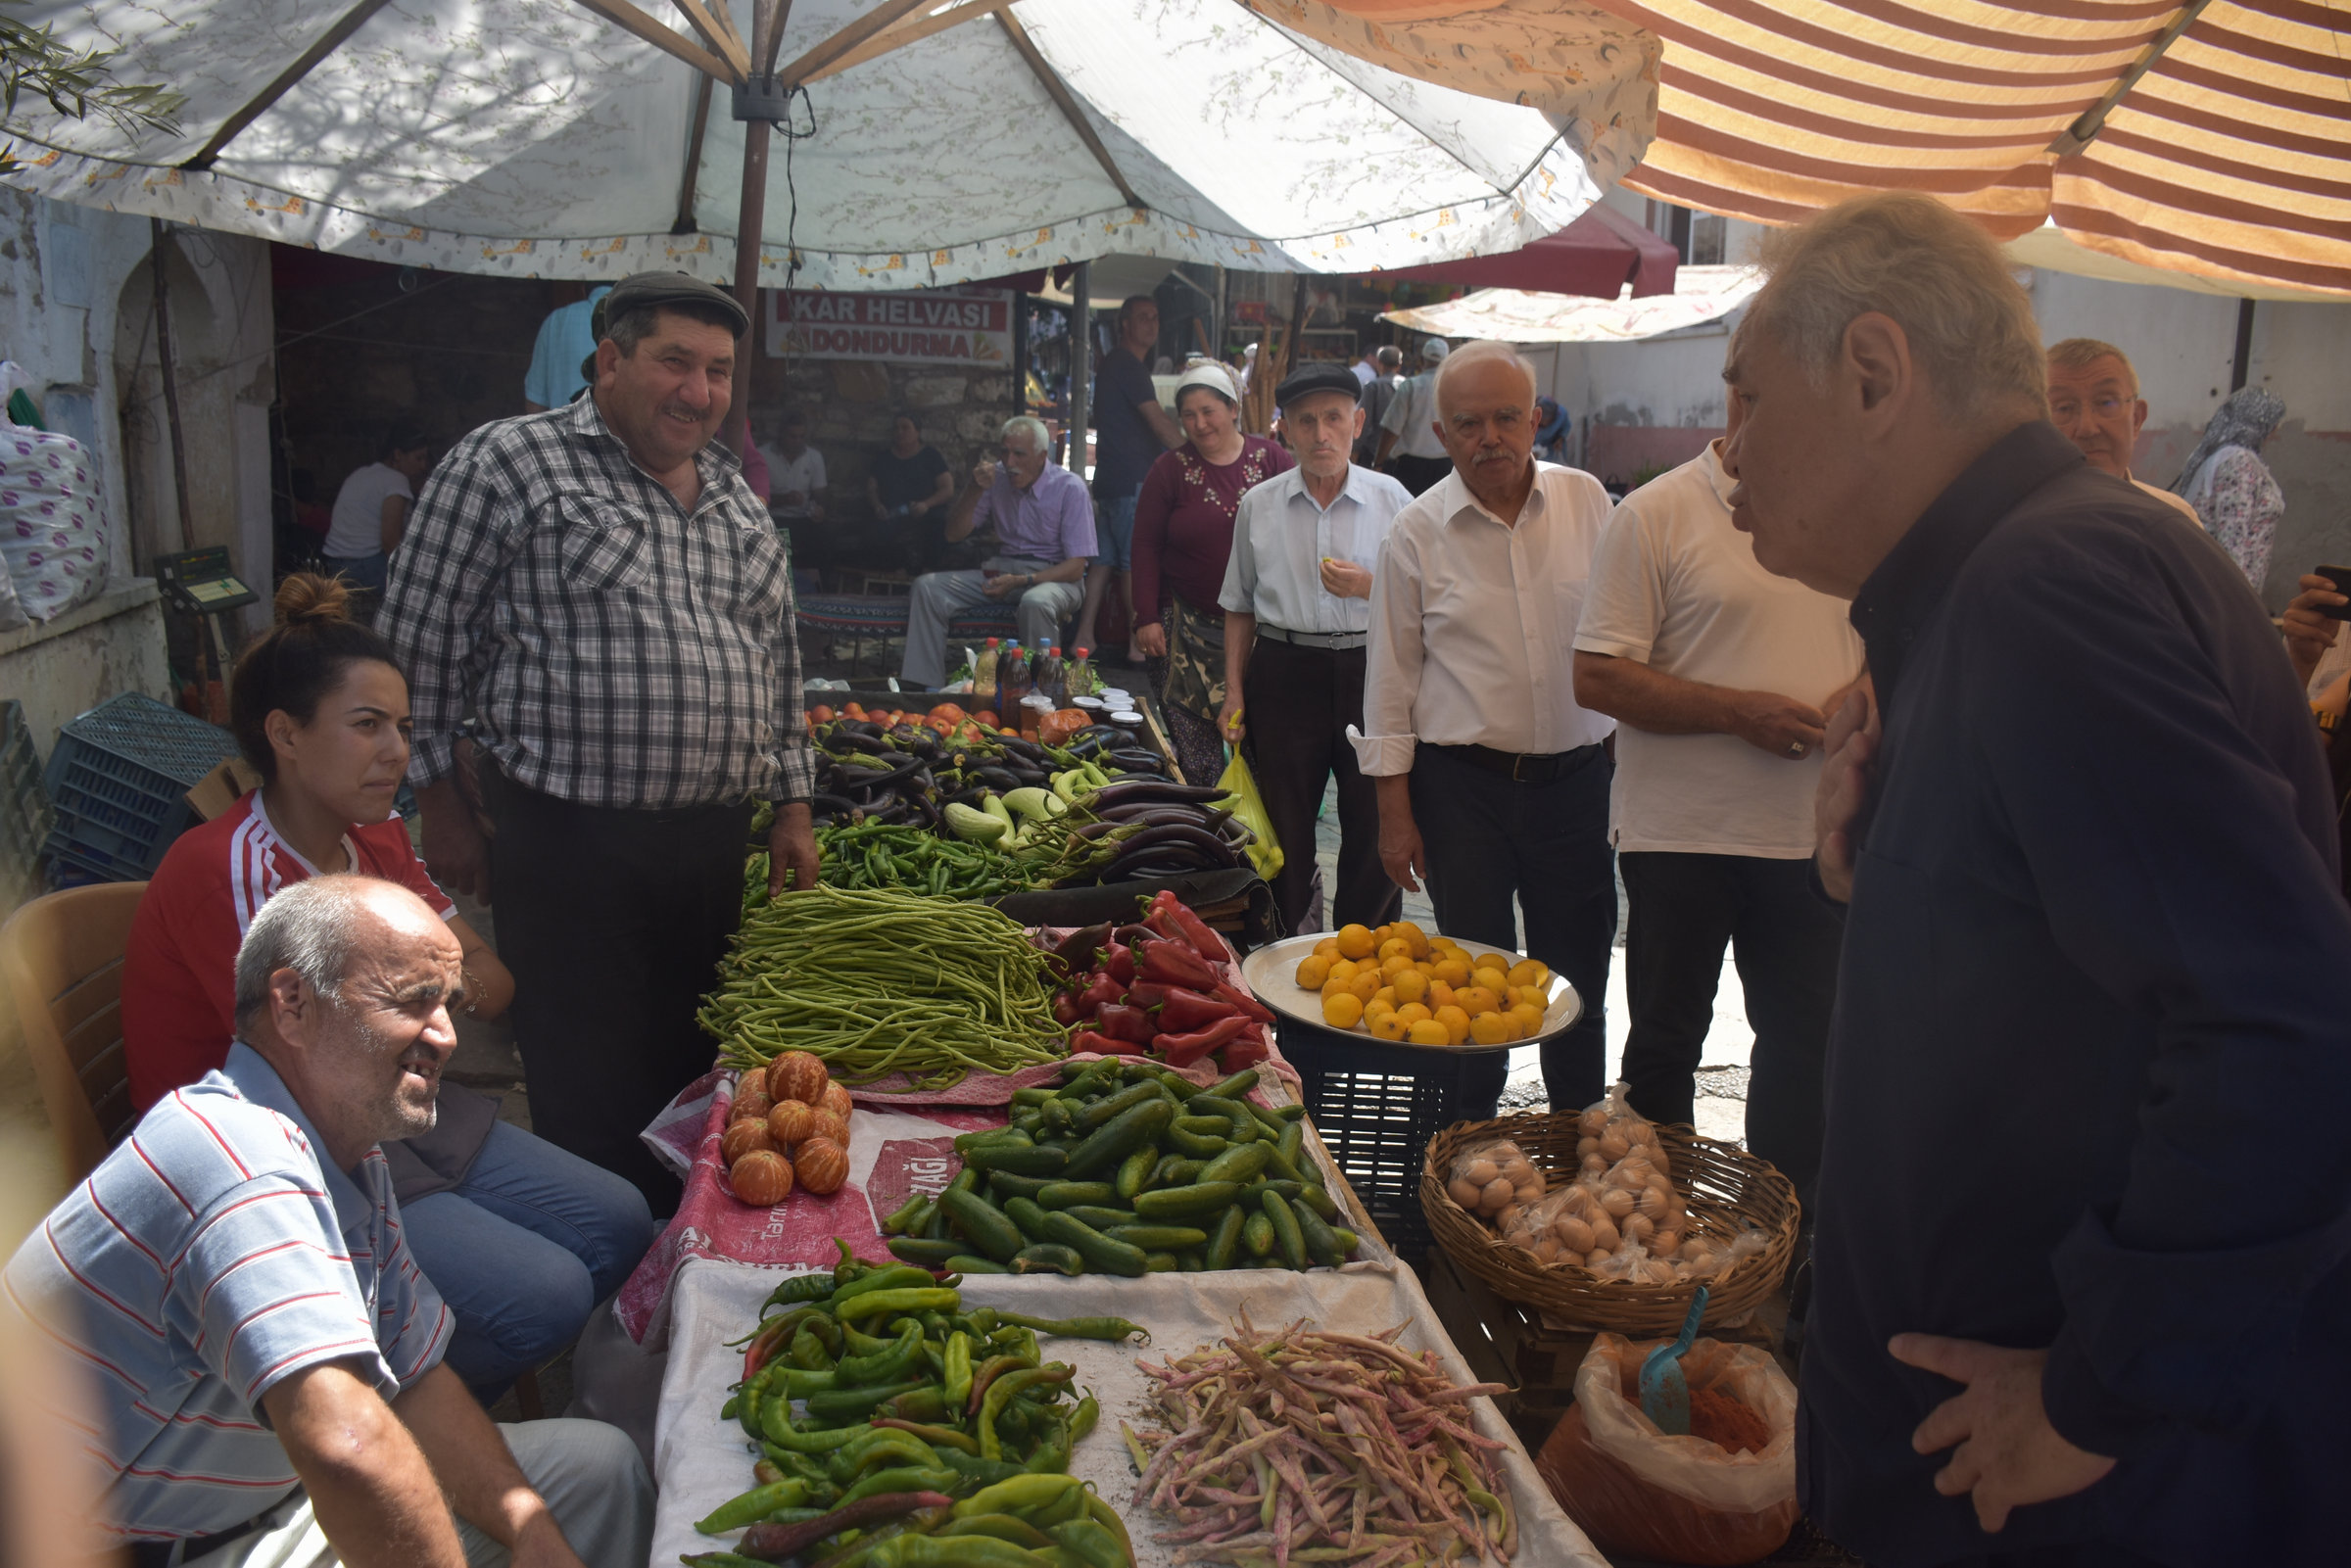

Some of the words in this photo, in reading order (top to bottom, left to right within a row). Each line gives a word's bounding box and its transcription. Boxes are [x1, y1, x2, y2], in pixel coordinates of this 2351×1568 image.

[794, 296, 856, 322] KAR
[867, 298, 990, 328] HELVASI
[812, 329, 971, 358] DONDURMA
[902, 1157, 948, 1203] ZAĞI
